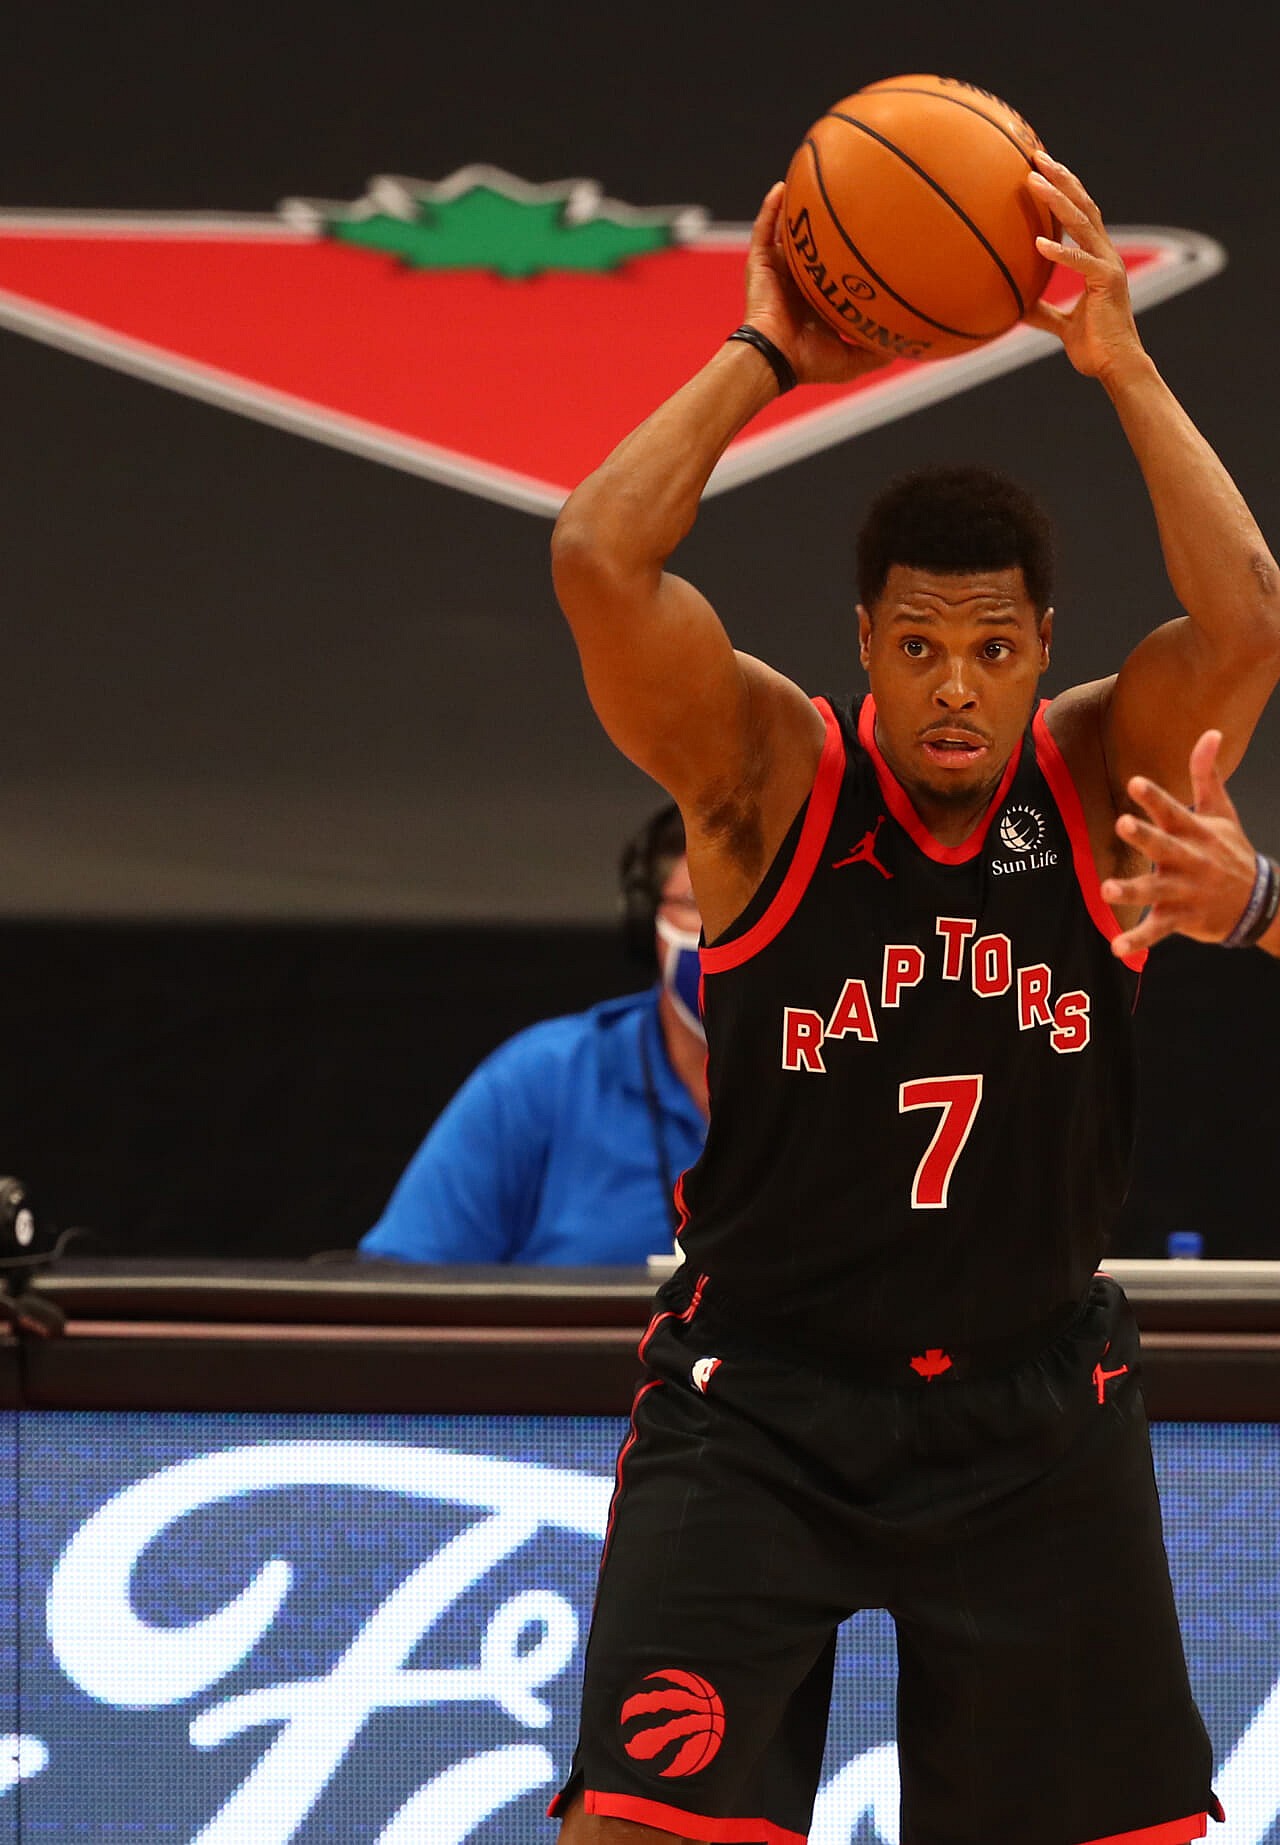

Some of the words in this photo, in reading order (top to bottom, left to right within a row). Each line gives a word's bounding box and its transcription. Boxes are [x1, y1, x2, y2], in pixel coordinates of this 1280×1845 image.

[788, 207, 932, 356] SPALDING
[991, 859, 1027, 876] Sun
[1029, 849, 1058, 869] Life
[781, 916, 1091, 1073] RAPTORS
[899, 1074, 984, 1209] 7
